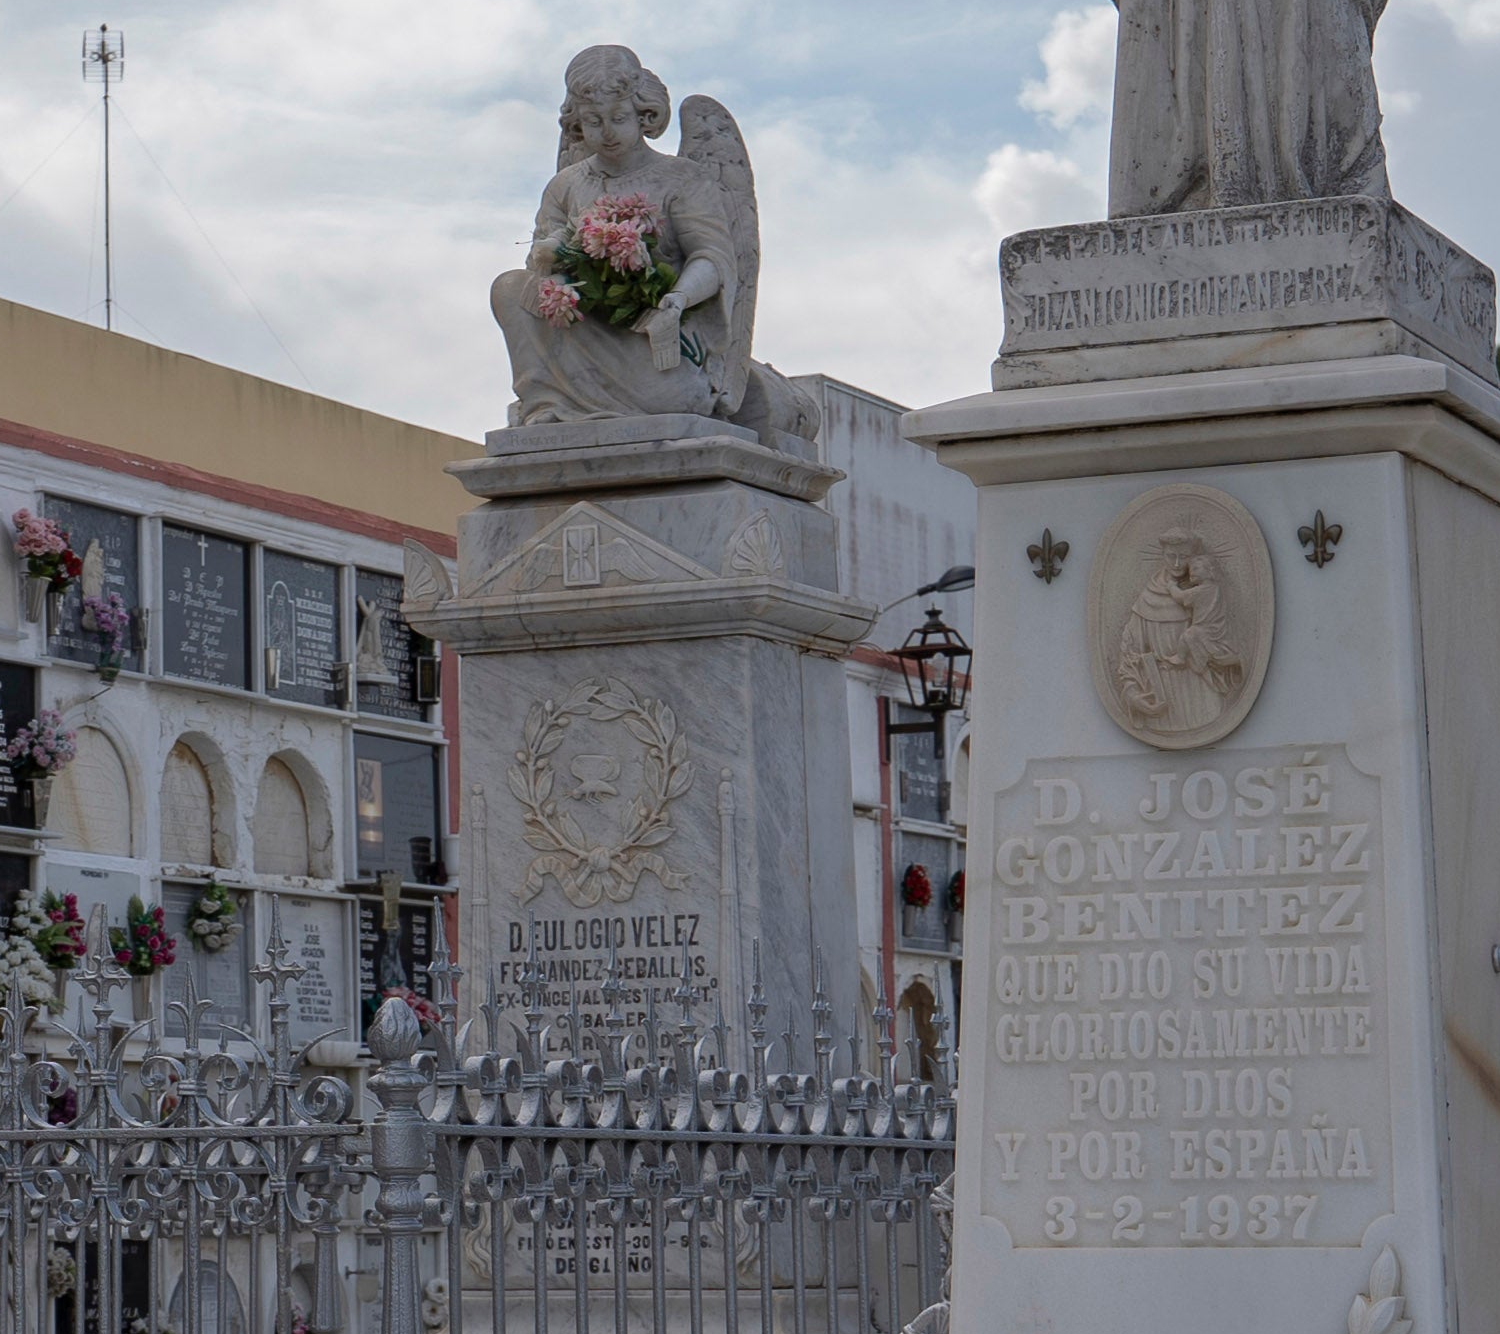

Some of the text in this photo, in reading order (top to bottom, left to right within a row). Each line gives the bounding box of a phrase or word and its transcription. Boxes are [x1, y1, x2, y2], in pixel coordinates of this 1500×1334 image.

[1058, 278, 1173, 328] ANTONIO
[1178, 270, 1274, 318] ROMAN
[1034, 750, 1330, 829] D. JOSÉ
[995, 824, 1371, 886] GONZALEZ
[631, 913, 701, 949] VELEZ
[1001, 884, 1364, 945] BENITEZ
[995, 944, 1372, 1005] QUE DIO SU VIDA
[995, 1005, 1372, 1064] GLORIOSAMENTE
[1069, 1067, 1294, 1123] POR DIOS
[994, 1112, 1373, 1182] Y POR ESPAÑA
